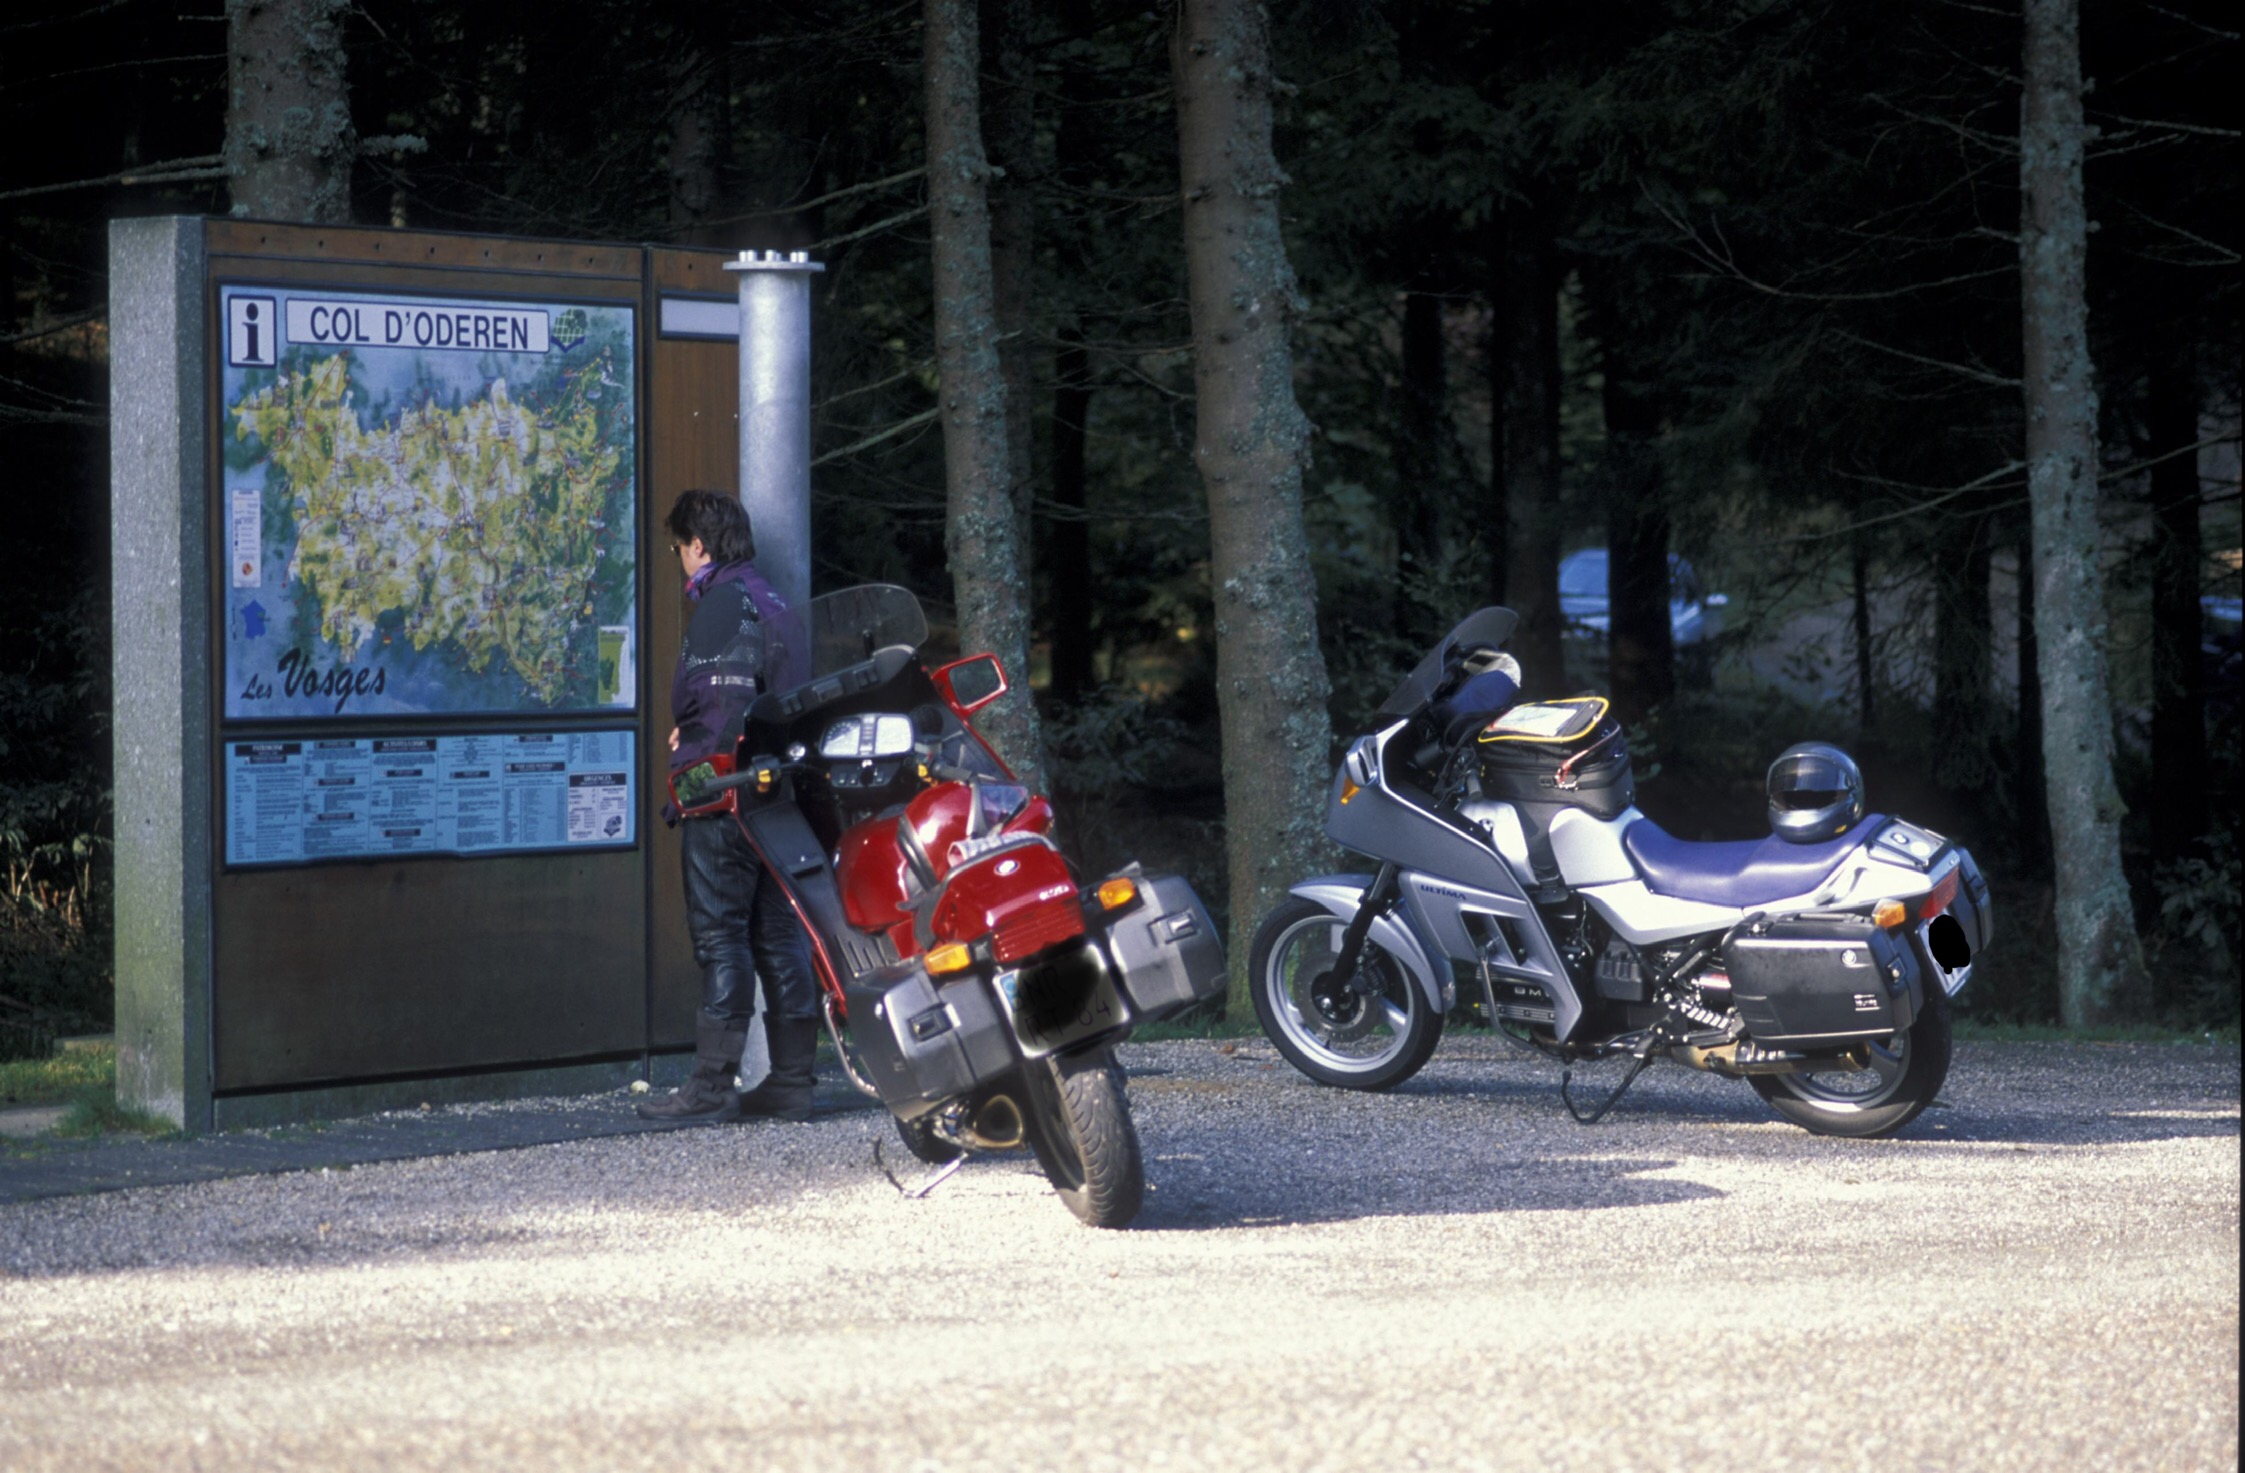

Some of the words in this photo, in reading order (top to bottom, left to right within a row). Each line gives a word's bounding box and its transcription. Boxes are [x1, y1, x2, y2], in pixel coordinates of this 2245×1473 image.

[242, 302, 264, 362] i
[310, 306, 370, 342] COL
[385, 310, 528, 350] D'ODEREN
[240, 673, 273, 700] Les
[277, 647, 386, 714] Vosges
[1514, 985, 1550, 998] BM
